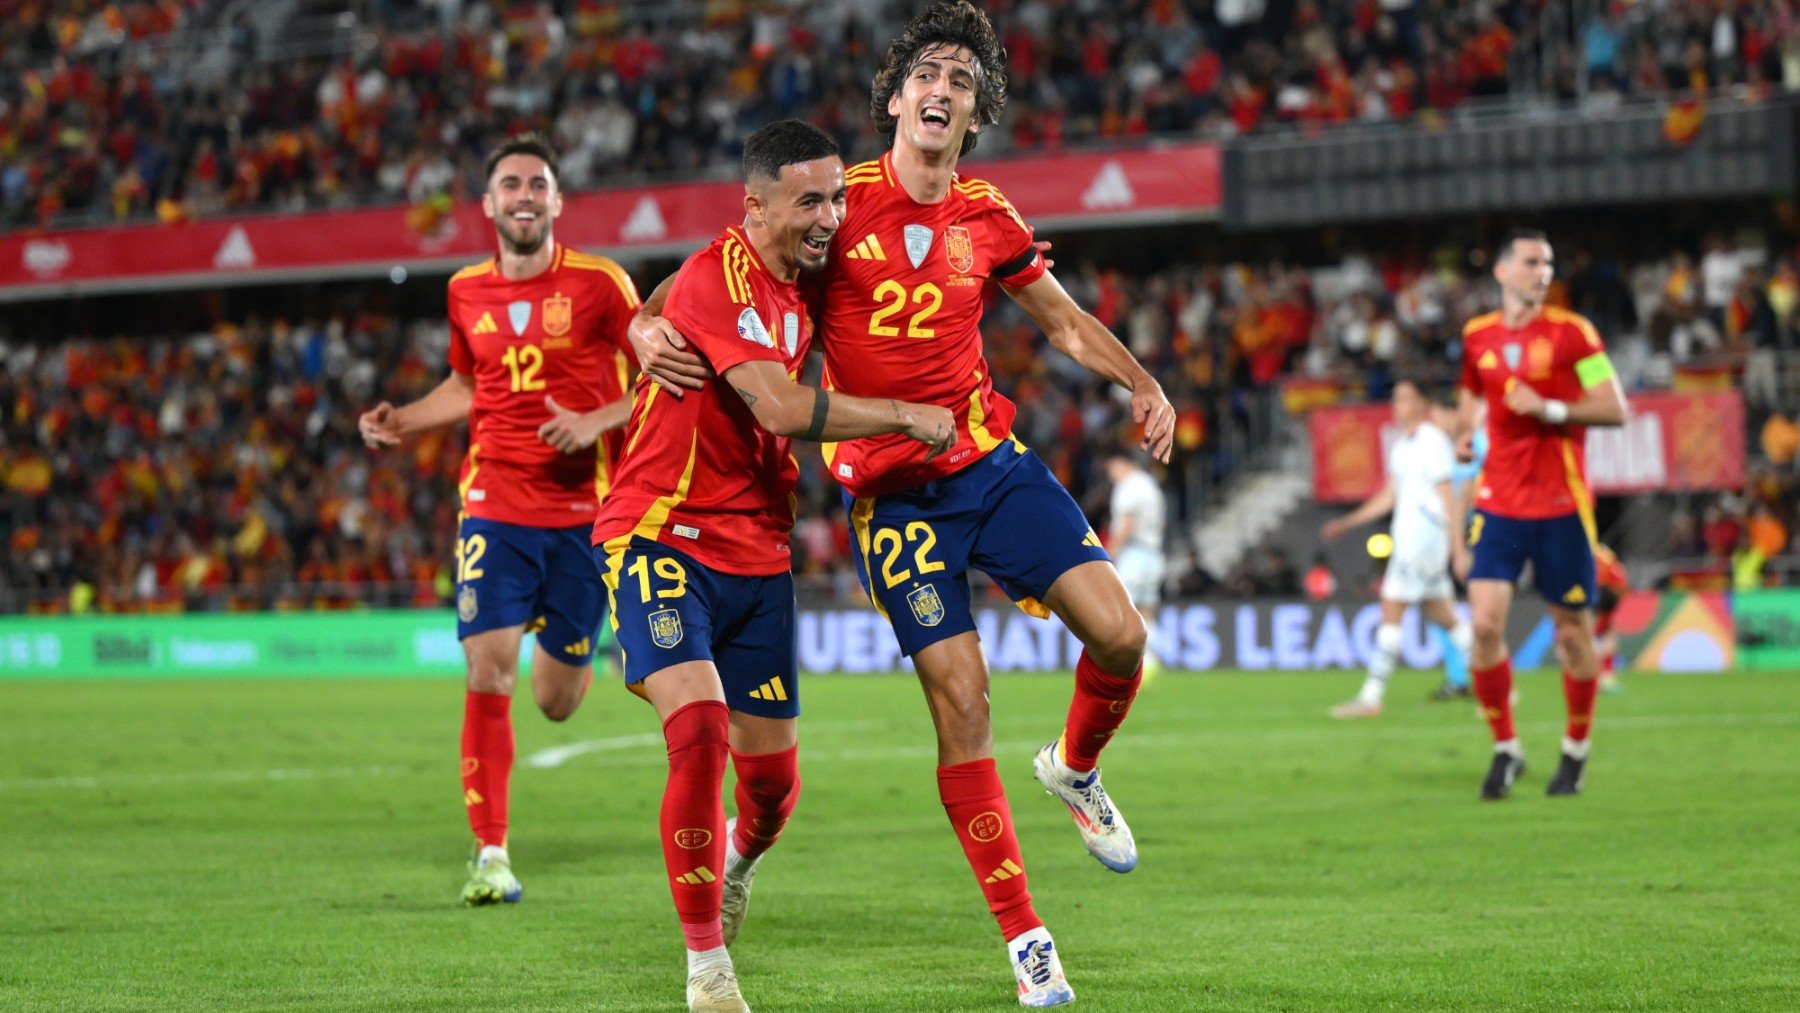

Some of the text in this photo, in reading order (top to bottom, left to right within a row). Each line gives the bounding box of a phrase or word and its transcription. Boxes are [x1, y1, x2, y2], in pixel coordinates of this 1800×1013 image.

[868, 279, 942, 338] 22
[501, 343, 546, 392] 12
[455, 533, 487, 583] 12
[627, 555, 687, 604] 19
[873, 521, 945, 589] 22
[798, 607, 914, 674] UEF
